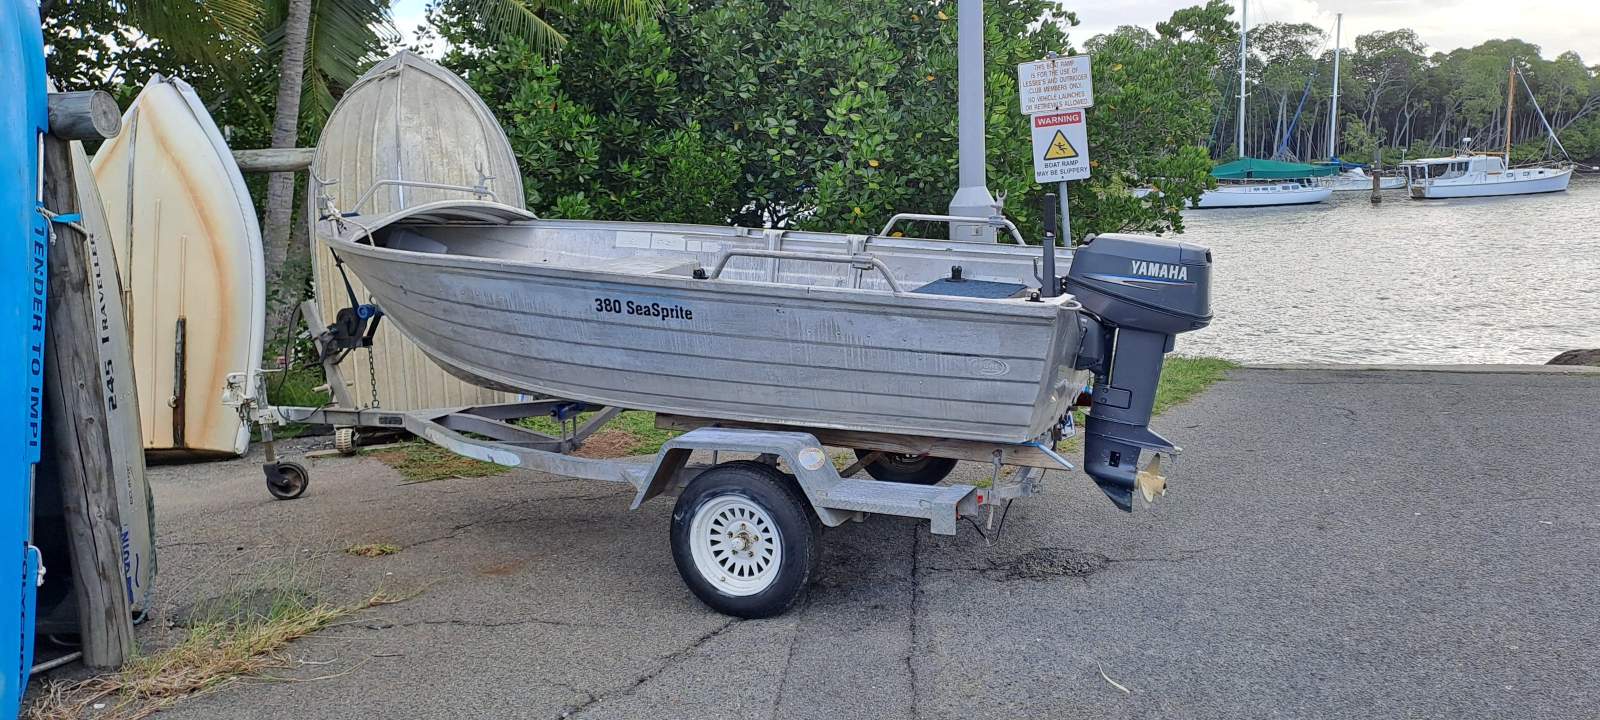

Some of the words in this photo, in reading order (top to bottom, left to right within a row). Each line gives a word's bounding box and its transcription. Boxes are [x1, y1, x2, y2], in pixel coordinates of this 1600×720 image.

[1036, 94, 1057, 102] VEHICLE
[1043, 84, 1067, 93] MEMBERS
[1037, 114, 1079, 125] WARNING
[1044, 161, 1060, 169] BOAT
[1060, 166, 1088, 175] SLIPPERY
[32, 227, 44, 333] TENDER
[1132, 260, 1188, 280] YAMAHA
[595, 298, 622, 314] 380
[626, 300, 693, 321] SeaSprite
[31, 343, 41, 375] TO
[104, 359, 118, 411] 245
[29, 387, 39, 447] IMPI
